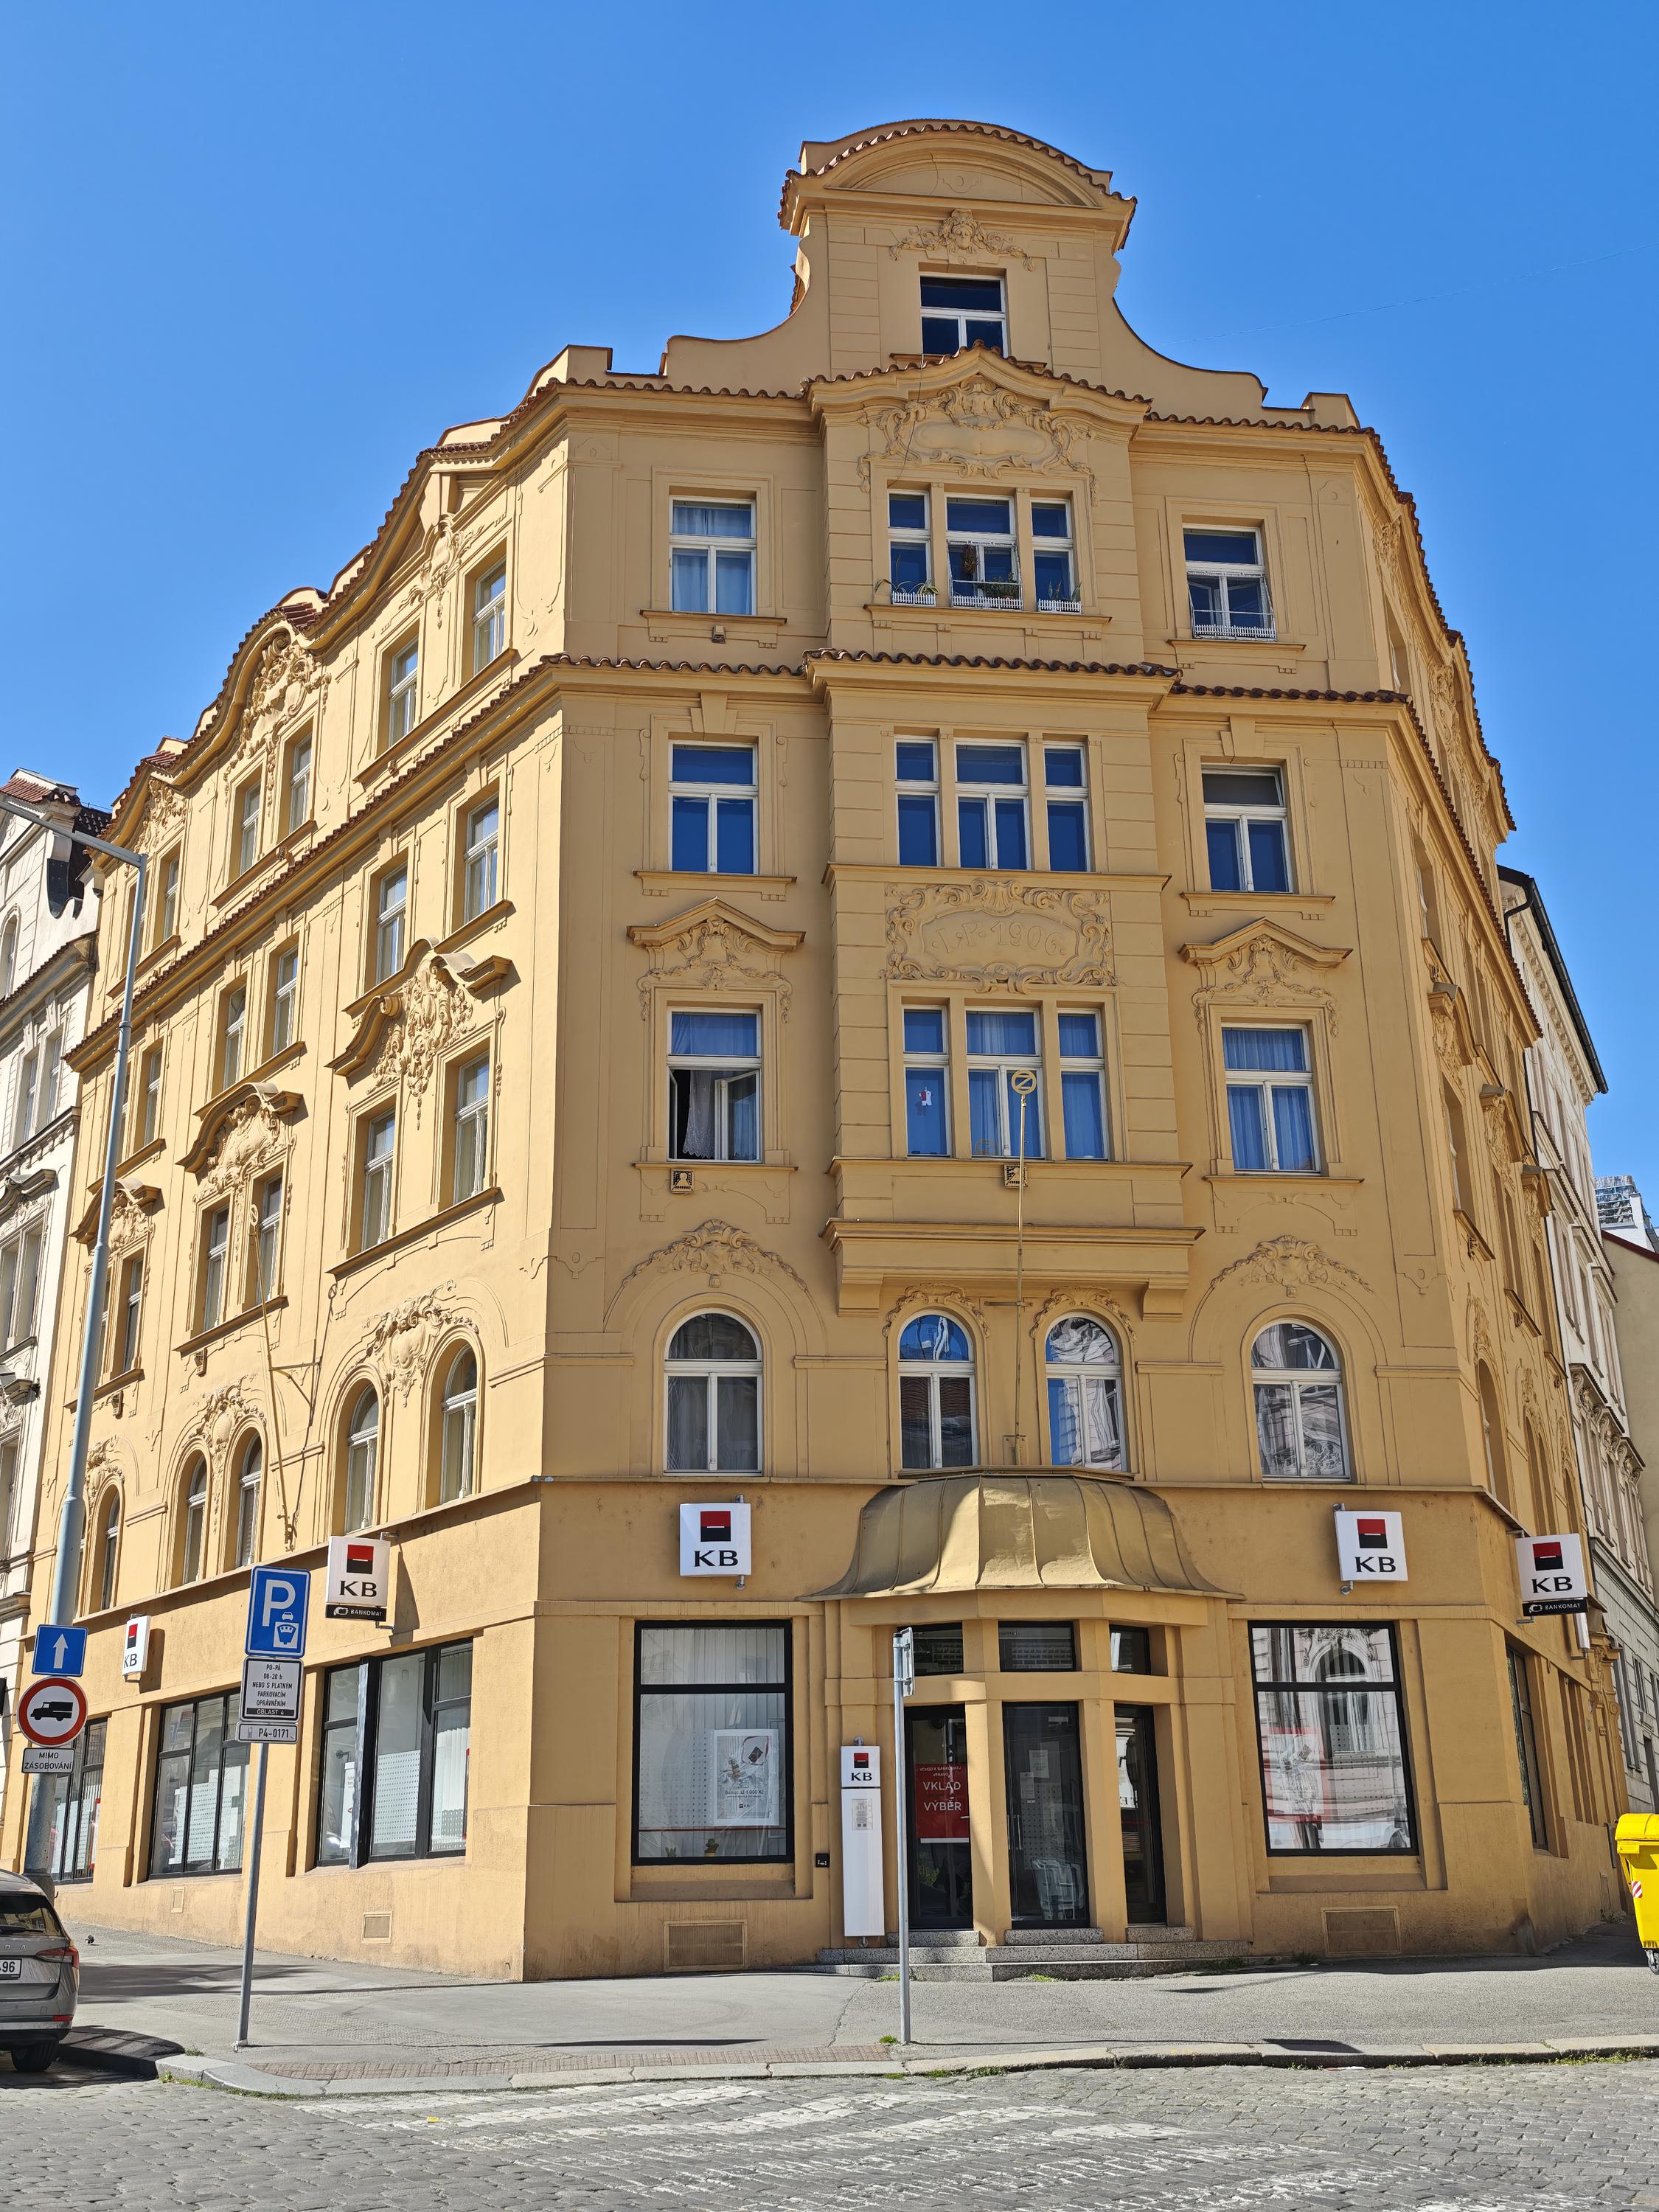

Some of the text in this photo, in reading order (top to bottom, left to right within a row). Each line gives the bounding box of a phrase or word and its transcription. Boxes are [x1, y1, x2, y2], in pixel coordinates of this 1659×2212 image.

[693, 1550, 738, 1567] KB
[1354, 1557, 1396, 1573] KB
[339, 1580, 378, 1597] KB
[1531, 1576, 1573, 1593] KB
[262, 1579, 295, 1627] P
[123, 1653, 137, 1669] KB
[271, 1681, 293, 1689] PLATNÝM
[256, 1699, 286, 1707] OPRÁVNĚNÍM
[258, 1728, 289, 1738] P4-0171
[24, 1761, 72, 1770] ZÁSOBOVÁNÍ
[851, 1772, 872, 1781] KB
[923, 1781, 961, 1791] VKLAD
[924, 1800, 961, 1811] VÝBĚR
[0, 1961, 15, 1973] 96
